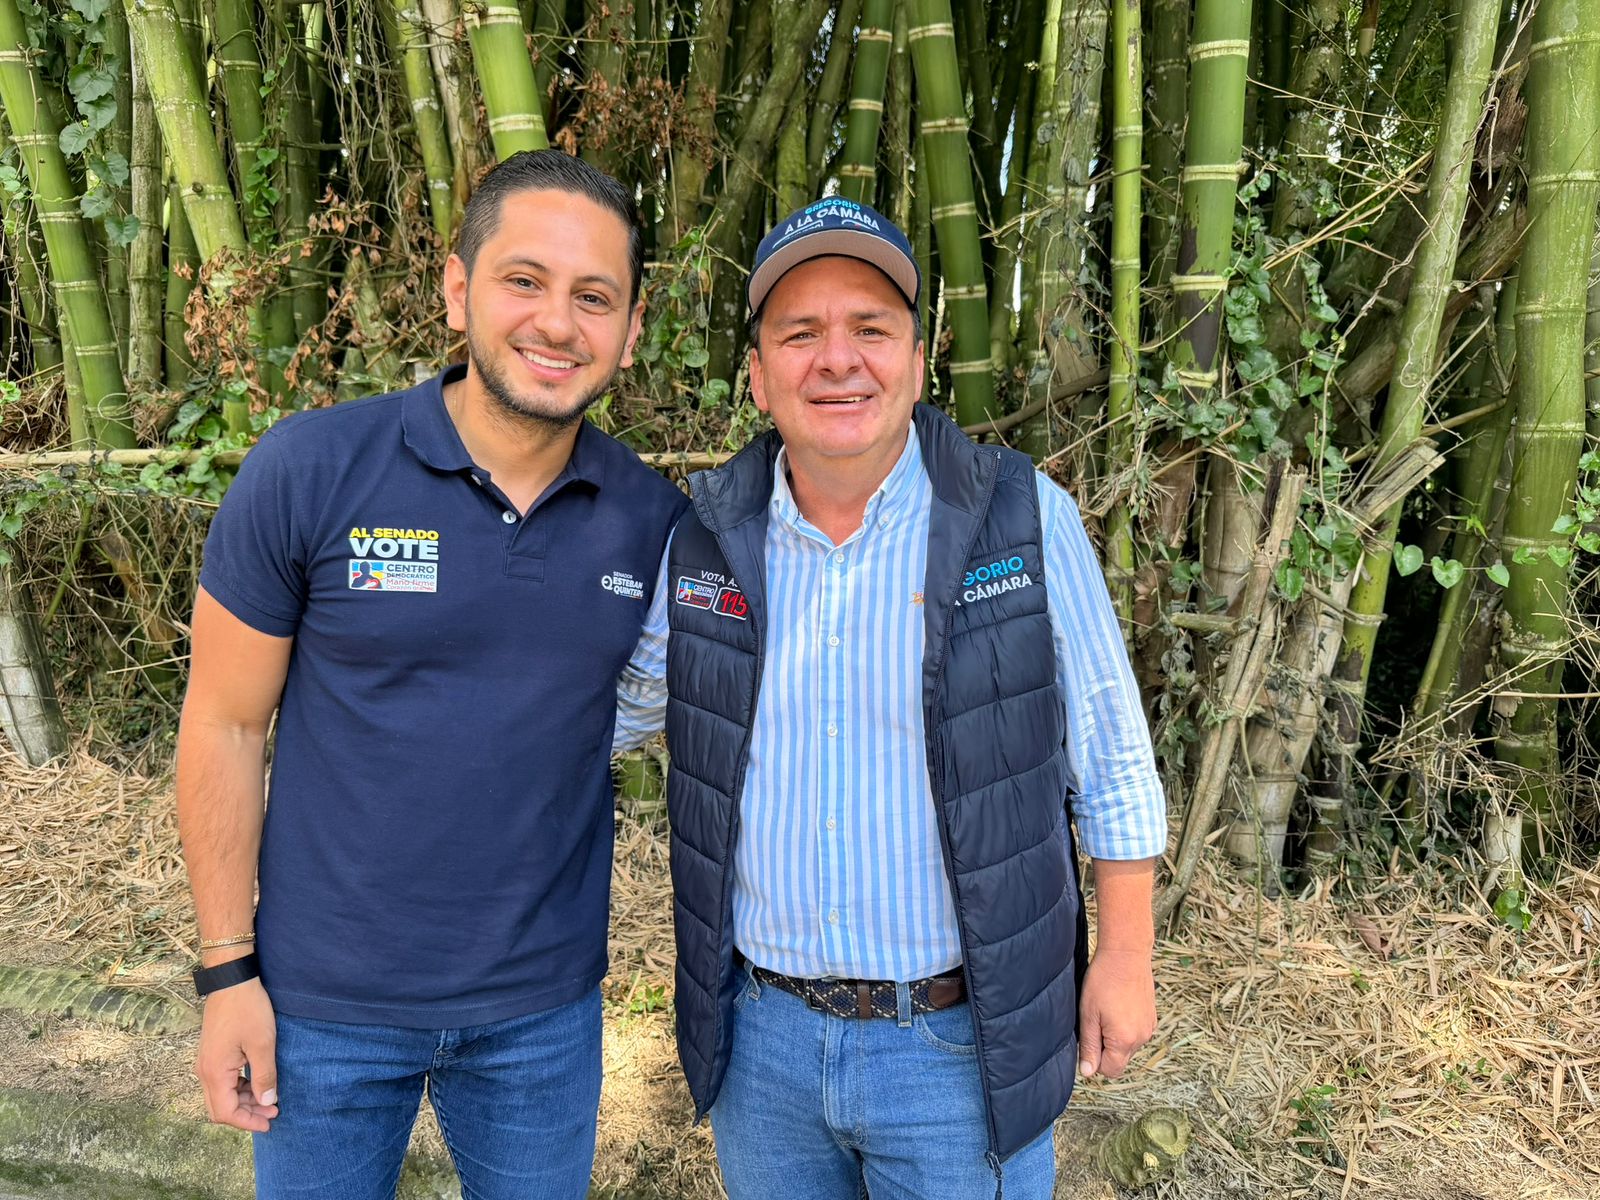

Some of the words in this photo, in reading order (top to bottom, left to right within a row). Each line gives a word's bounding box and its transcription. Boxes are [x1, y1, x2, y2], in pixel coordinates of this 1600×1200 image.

[805, 199, 861, 214] GREGORIO
[785, 224, 794, 235] A
[797, 215, 813, 228] LA
[817, 206, 880, 232] CÁMARA
[349, 528, 371, 538] AL
[373, 528, 439, 540] SENADO
[349, 537, 439, 560] VOTE
[386, 564, 435, 574] CENTRO
[613, 577, 643, 589] ESTEBAN
[701, 570, 725, 584] VOTA
[963, 573, 1032, 602] CÁMARA
[721, 591, 748, 616] 115
